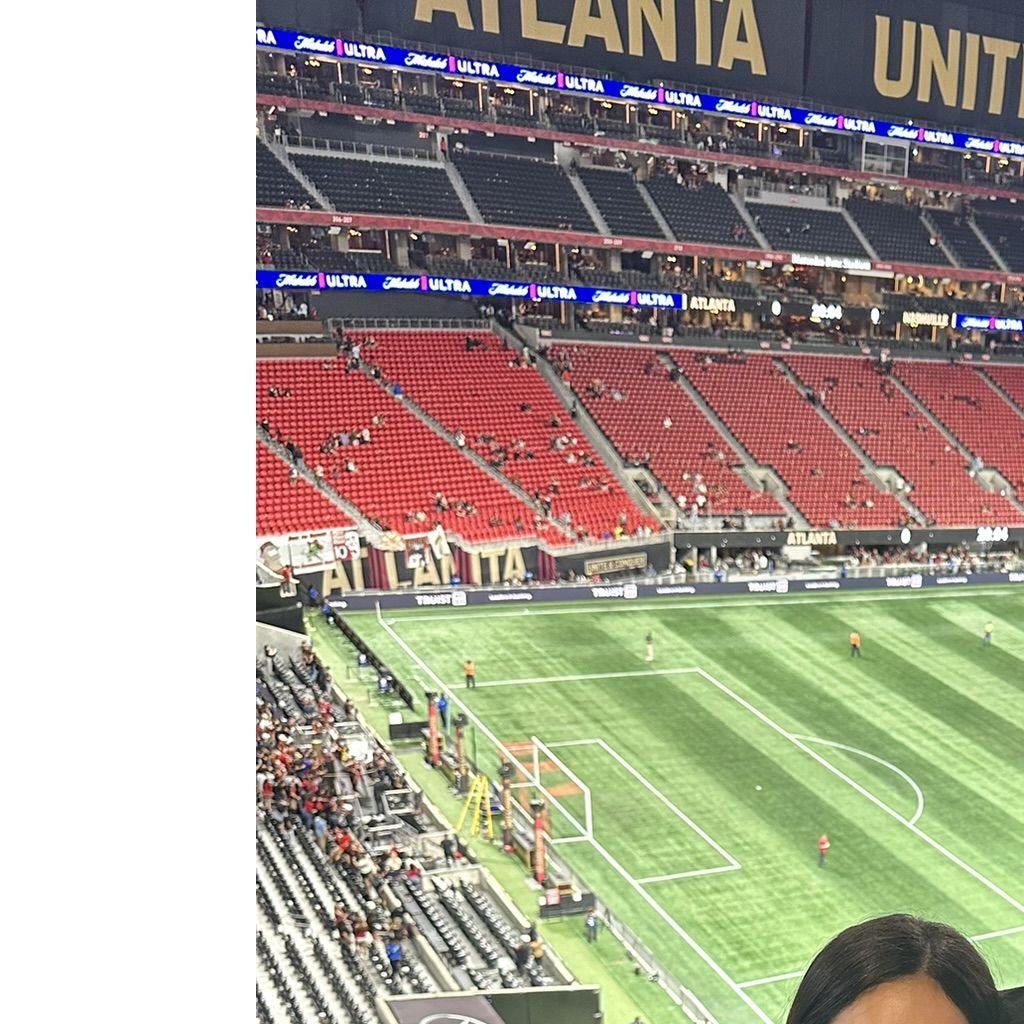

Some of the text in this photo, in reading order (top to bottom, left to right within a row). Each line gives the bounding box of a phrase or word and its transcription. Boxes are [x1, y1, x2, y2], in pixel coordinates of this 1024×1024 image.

[343, 43, 386, 61] ULTRA
[456, 60, 499, 78] ULTRA
[566, 76, 604, 92] ULTRA
[664, 91, 701, 107] ULTRA
[757, 105, 791, 120] ULTRA
[326, 275, 366, 287] ULTRA
[429, 279, 471, 292] ULTRA
[536, 286, 576, 300] ULTRA
[690, 296, 735, 312] ATLANTA
[787, 532, 837, 545] ATLANTA
